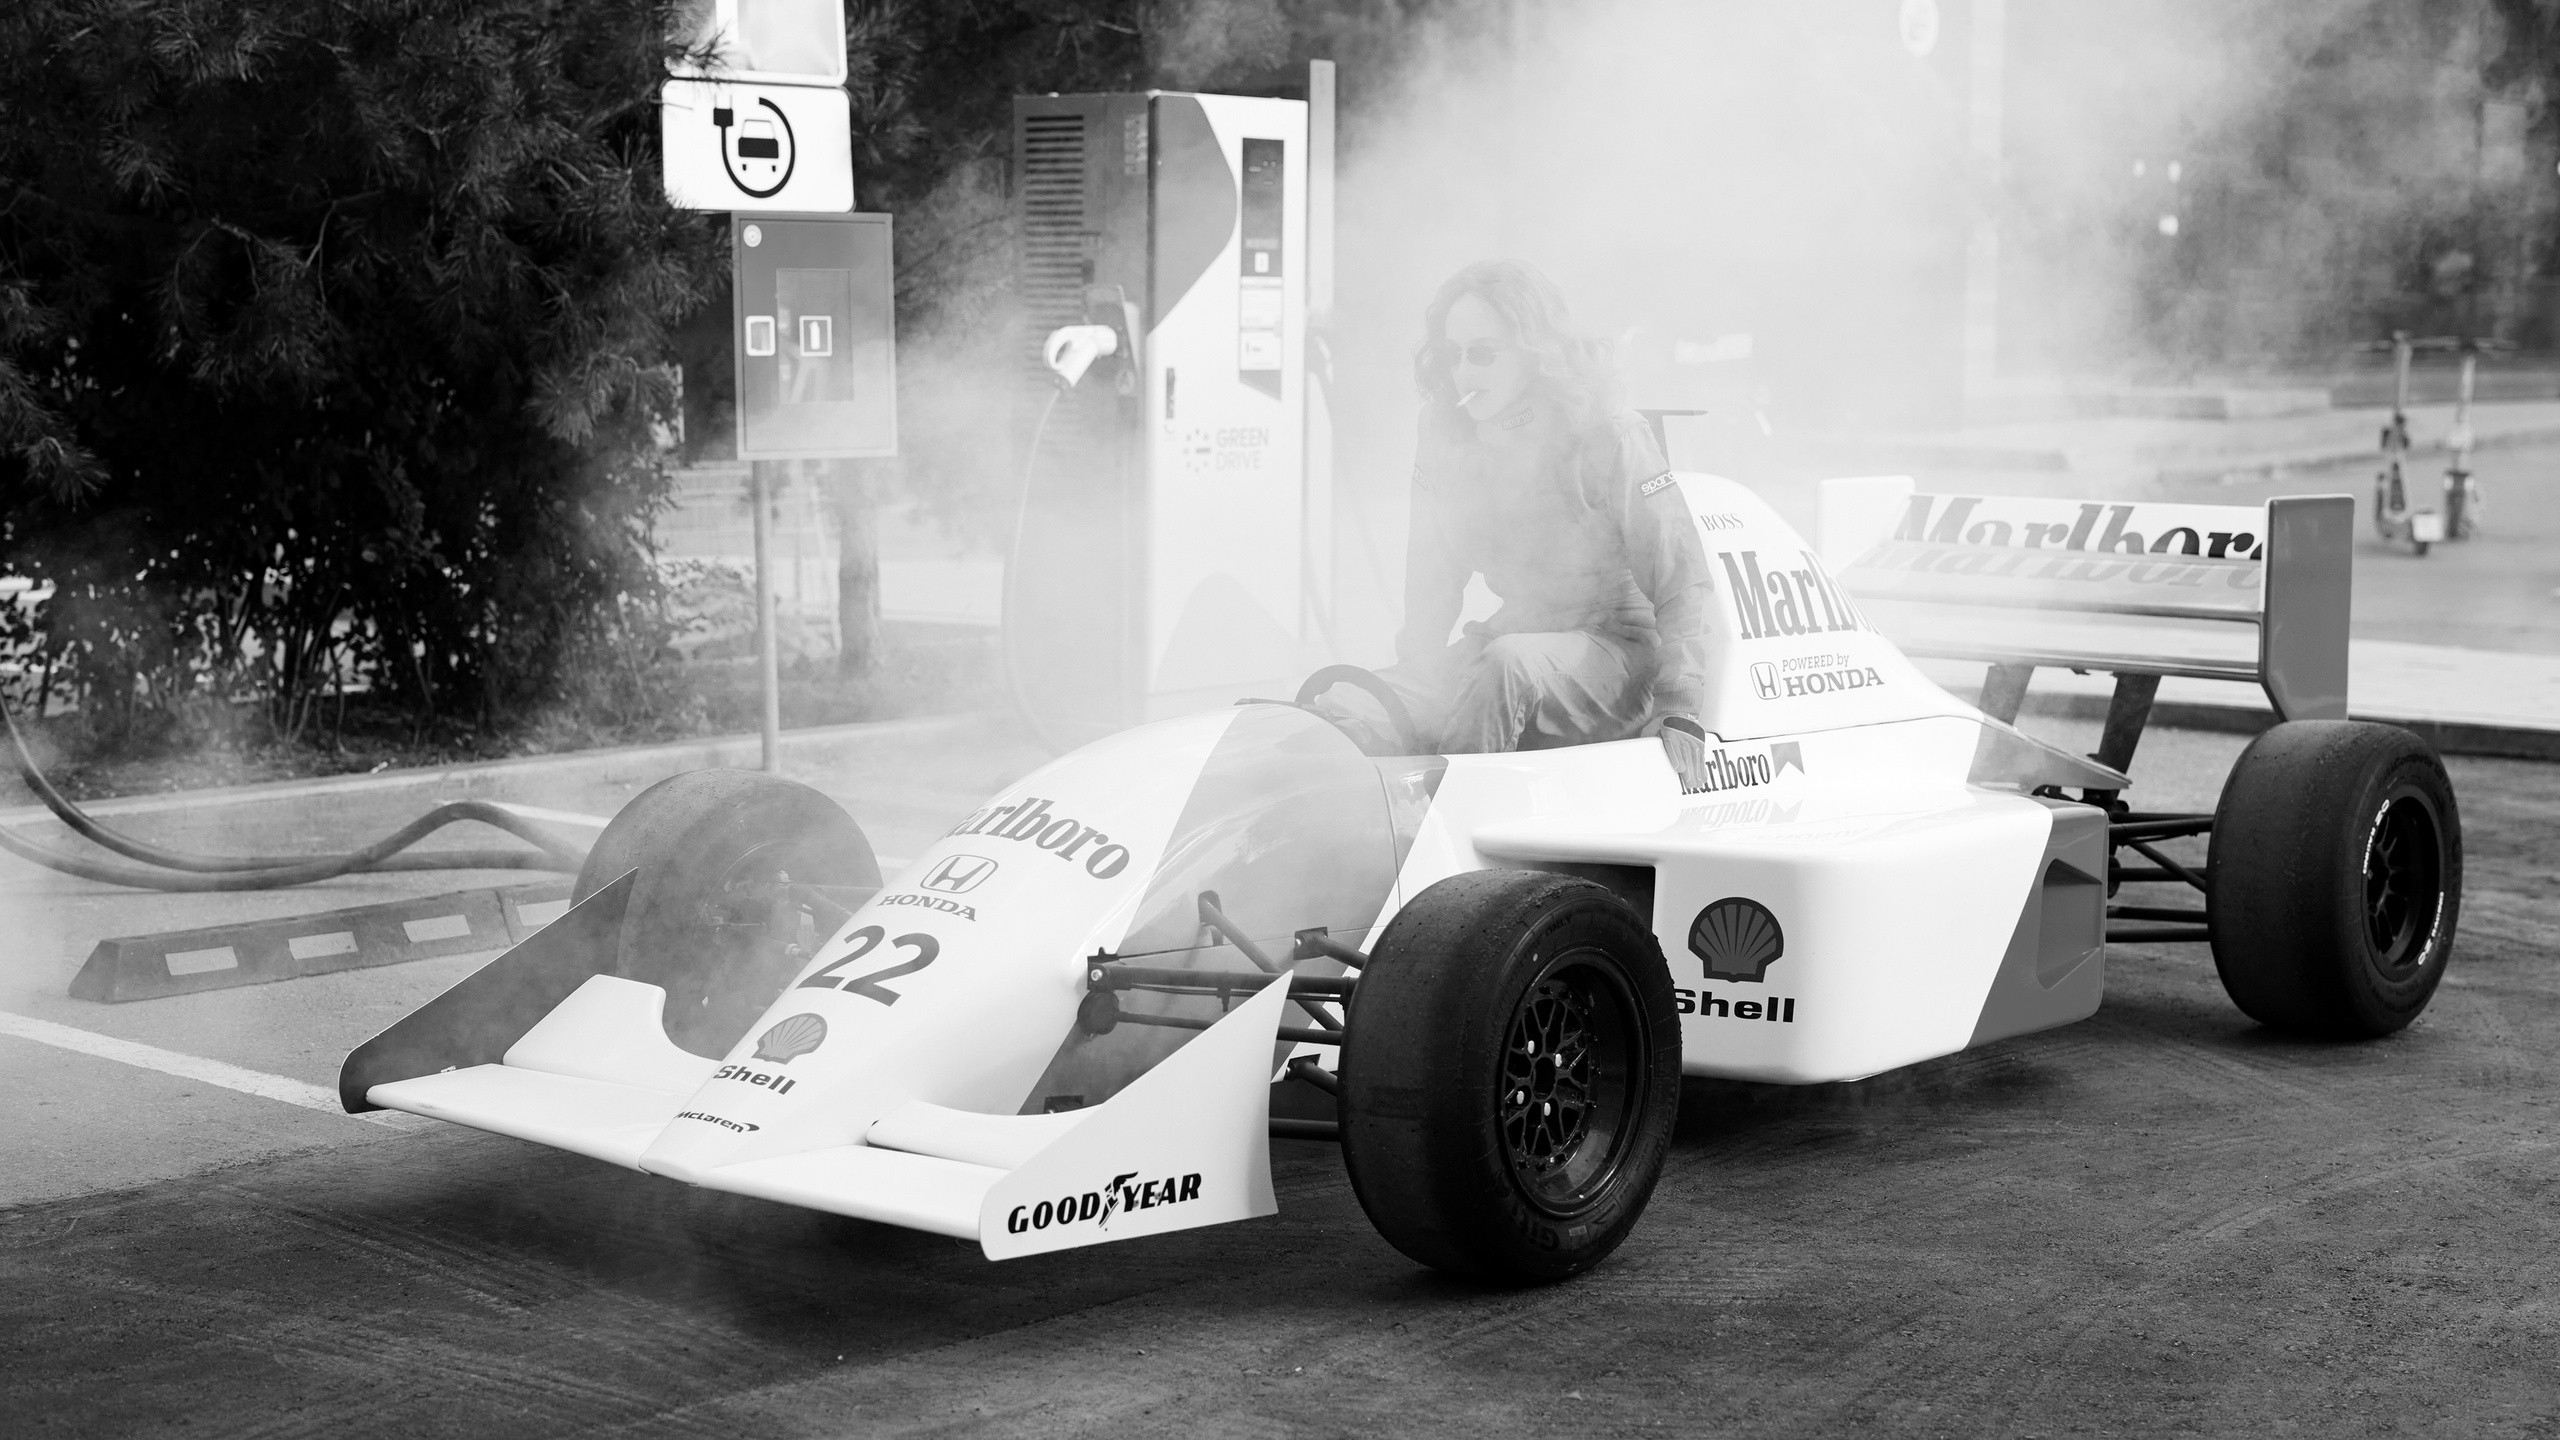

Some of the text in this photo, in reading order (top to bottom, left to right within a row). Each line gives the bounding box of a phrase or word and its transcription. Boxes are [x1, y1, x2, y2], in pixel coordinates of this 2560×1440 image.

[1216, 427, 1269, 448] GREEN
[1216, 450, 1261, 471] DRIVE
[1700, 513, 1744, 531] BOSS
[1782, 653, 1850, 672] POWERED by
[1783, 667, 1885, 697] HONDA
[1678, 749, 1770, 795] rlboro
[876, 894, 977, 922] HONDA
[795, 925, 940, 1007] 22
[713, 1065, 796, 1095] Shell
[672, 1111, 744, 1133] McLaren
